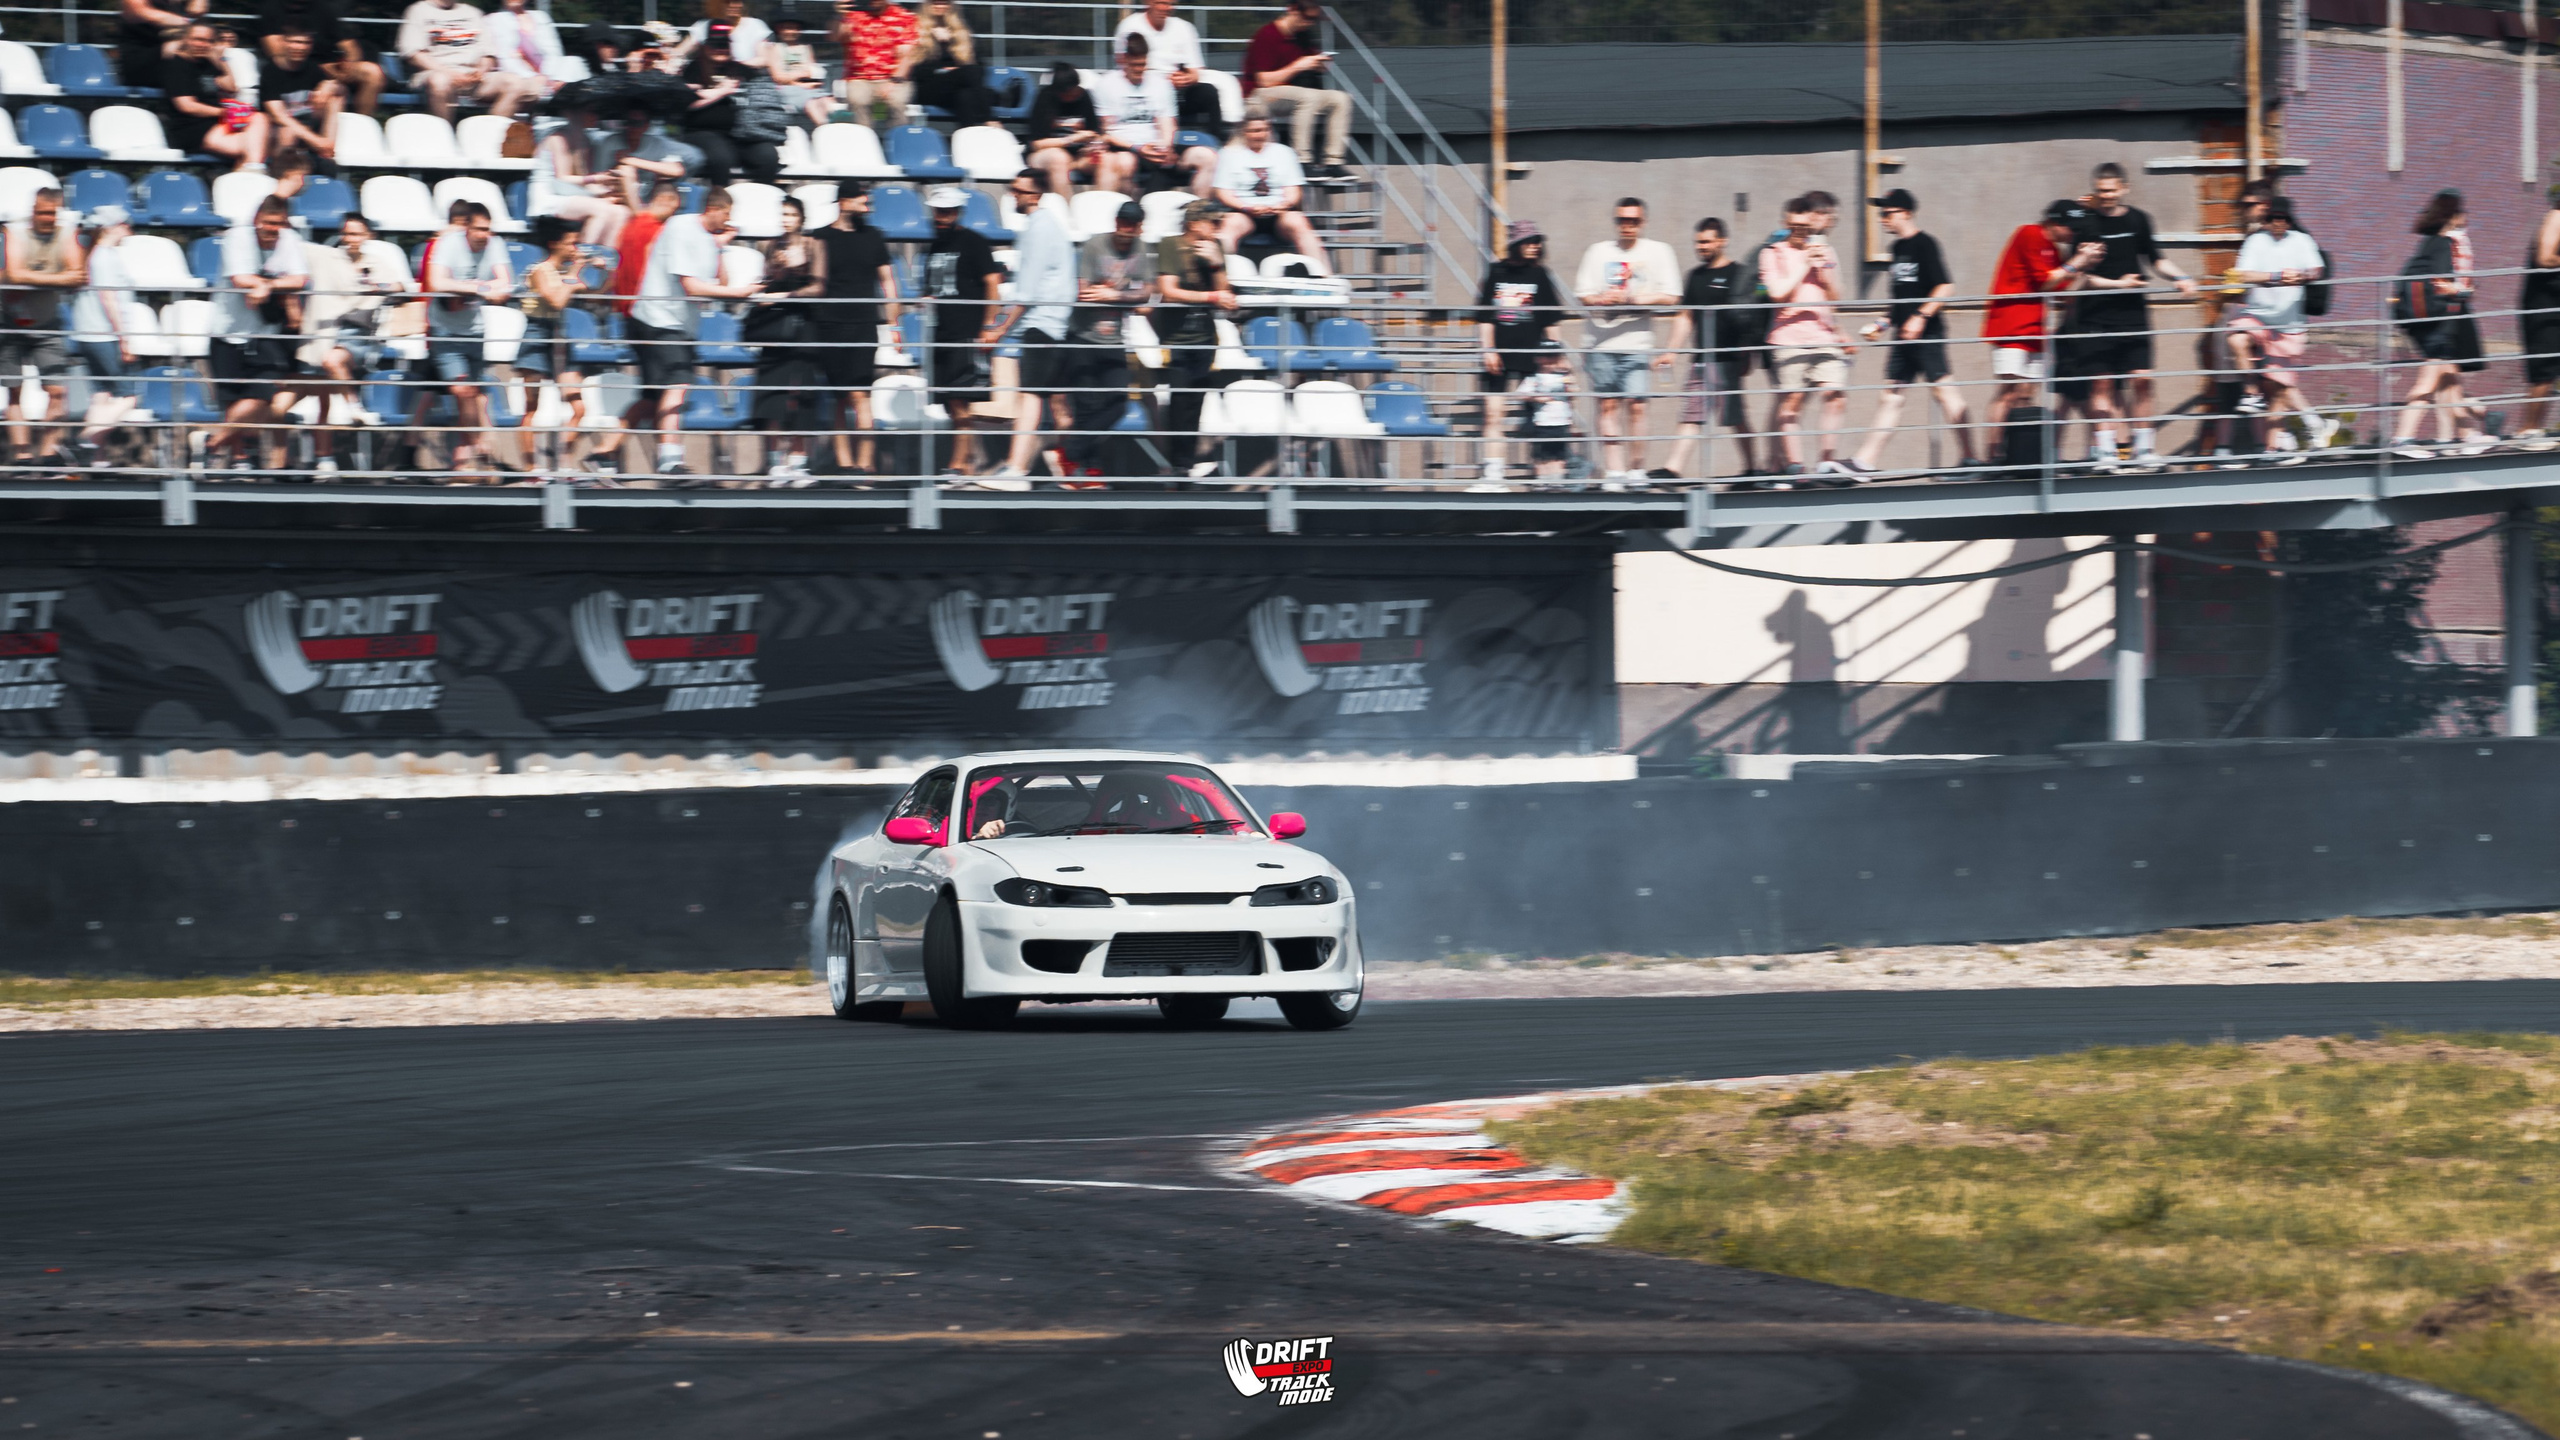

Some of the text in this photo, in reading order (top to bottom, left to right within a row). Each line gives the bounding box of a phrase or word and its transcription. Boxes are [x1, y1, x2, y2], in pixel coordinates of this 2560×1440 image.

[302, 594, 442, 637] DRIFT
[627, 594, 763, 636] DRIFT
[983, 593, 1115, 635] DRIFT
[1302, 599, 1432, 640] DRIFT
